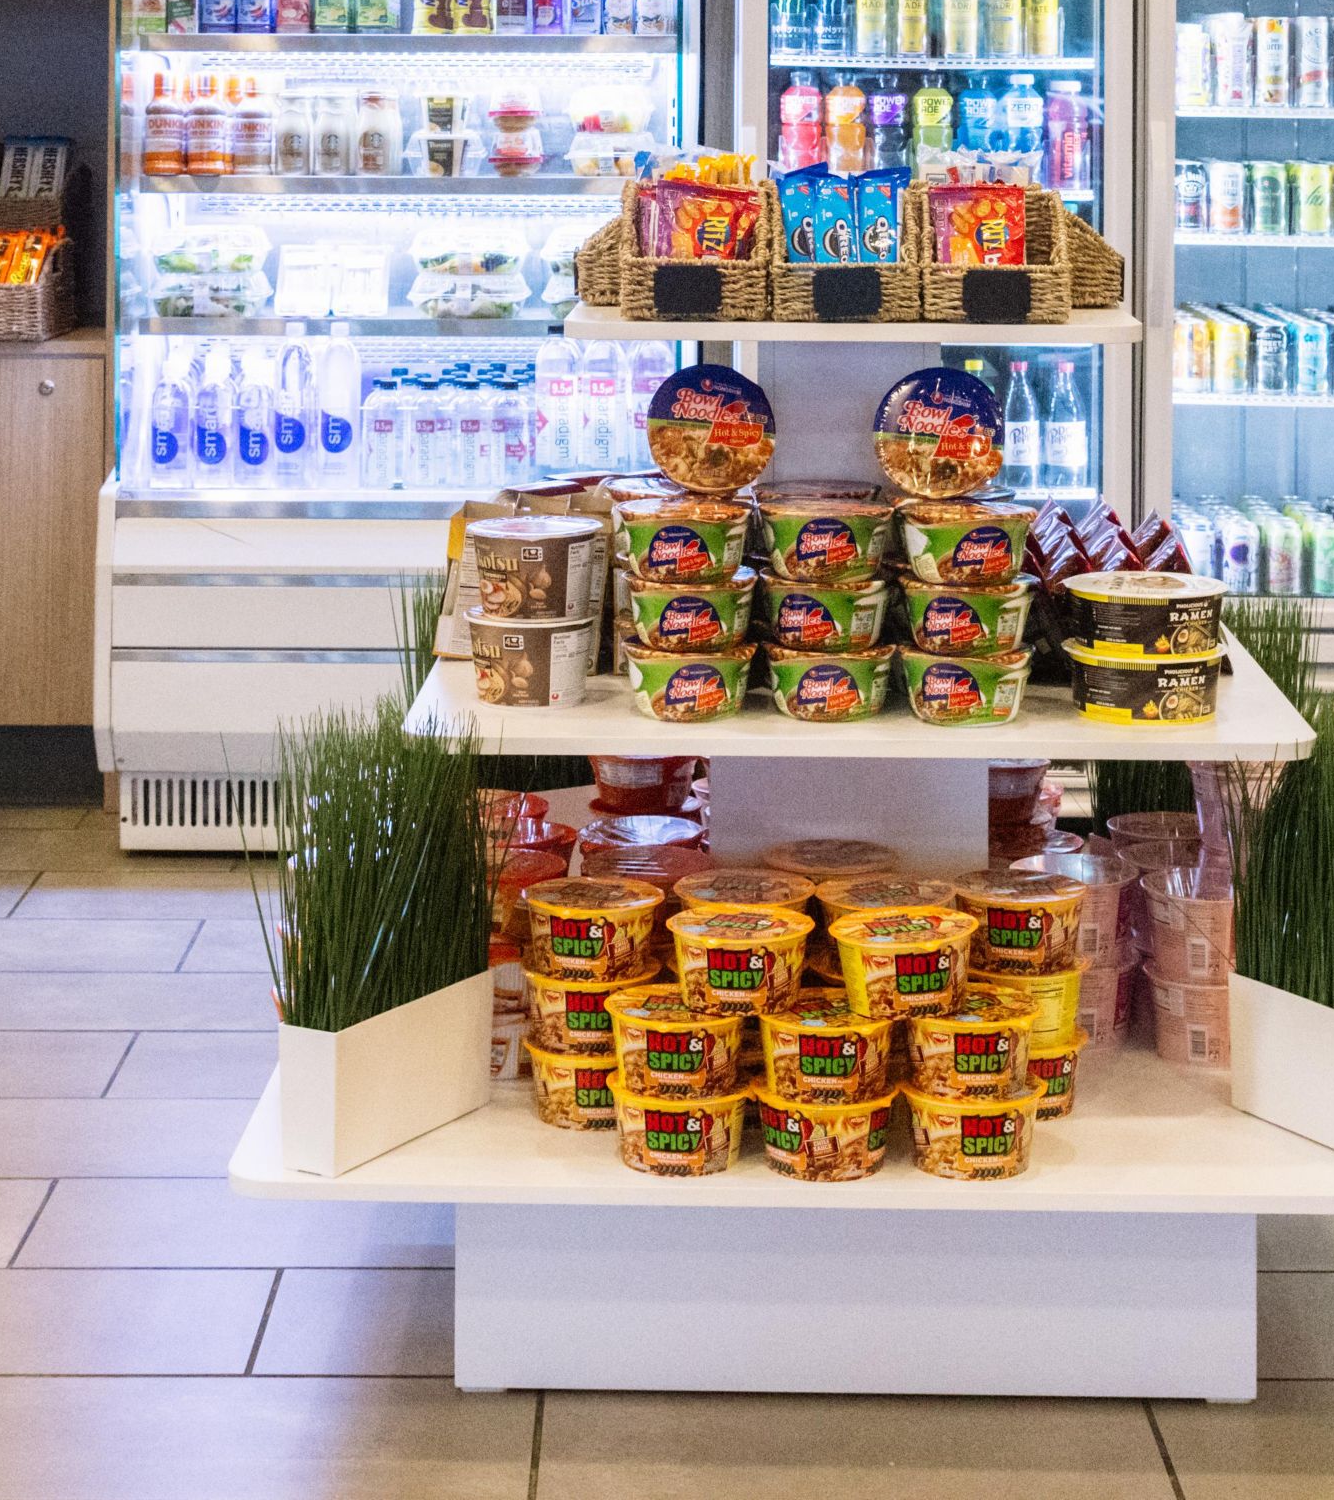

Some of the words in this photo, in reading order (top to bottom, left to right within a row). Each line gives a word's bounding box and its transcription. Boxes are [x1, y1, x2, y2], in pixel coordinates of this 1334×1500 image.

[1063, 131, 1074, 179] vitamin
[702, 216, 730, 252] RITZ
[982, 217, 1005, 252] RITZ
[676, 387, 724, 407] Bowl
[671, 401, 741, 425] Noodles
[905, 399, 953, 419] Bowl
[714, 428, 731, 437] Hot
[731, 428, 739, 437] &
[739, 428, 761, 439] Spicy
[897, 414, 970, 438] Noodles
[941, 442, 958, 451] Hot
[958, 442, 967, 451] &
[801, 531, 834, 543] Bowl
[653, 539, 683, 551] Bowl
[799, 538, 848, 553] Noodles
[961, 540, 993, 552] Bowl
[651, 548, 698, 560] Noodles
[957, 548, 1006, 563] Noodles
[665, 609, 695, 621] Bowl
[780, 607, 806, 619] Bowl
[928, 610, 955, 622] Bowl
[1169, 609, 1214, 622] RAMEN
[662, 617, 710, 630] Noodles
[780, 615, 822, 628] Noodles
[925, 618, 971, 631] Noodles
[672, 676, 704, 688] Bowl
[803, 677, 834, 690] Bowl
[926, 675, 954, 687] Bowl
[1157, 675, 1206, 688] RAMEN
[669, 684, 717, 698] Noodles
[800, 685, 849, 699] Noodles
[924, 683, 970, 696] Noodles
[988, 908, 1028, 929] HOT
[1027, 916, 1042, 929] &
[550, 917, 590, 939] HOT
[589, 924, 603, 939] &
[989, 928, 1041, 948] SPICY
[552, 938, 603, 957] SPICY
[991, 947, 1024, 955] CHICKEN
[554, 957, 586, 966] CHICKEN
[707, 949, 749, 971] HOT
[749, 955, 764, 969] &
[895, 951, 938, 974] HOT
[938, 954, 950, 969] &
[709, 970, 764, 989] SPICY
[897, 972, 950, 993] SPICY
[711, 989, 746, 998] CHICKEN
[900, 993, 934, 1002] CHICKEN
[567, 1012, 609, 1031] SPIC
[646, 1031, 689, 1052] HOT
[688, 1037, 703, 1051] &
[799, 1035, 842, 1057] HOT
[842, 1042, 855, 1056] &
[954, 1033, 997, 1053] HOT
[997, 1038, 1009, 1051] &
[648, 1052, 702, 1072] SPICY
[801, 1056, 855, 1076] SPICY
[956, 1053, 1007, 1073] SPICY
[650, 1071, 684, 1080] CHICKEN
[802, 1076, 837, 1084] CHICKEN
[957, 1073, 992, 1082] CHICKEN
[644, 1111, 687, 1131] HOT
[687, 1117, 701, 1131] &
[762, 1105, 787, 1131] HOT
[786, 1118, 800, 1132] &
[961, 1114, 1002, 1136] HOT
[1003, 1120, 1015, 1133] &
[646, 1131, 701, 1152] SPICY
[765, 1129, 801, 1150] SPICY
[962, 1135, 1015, 1156] SPICY
[649, 1151, 683, 1160] CHICKEN
[964, 1156, 999, 1164] CHICKEN
